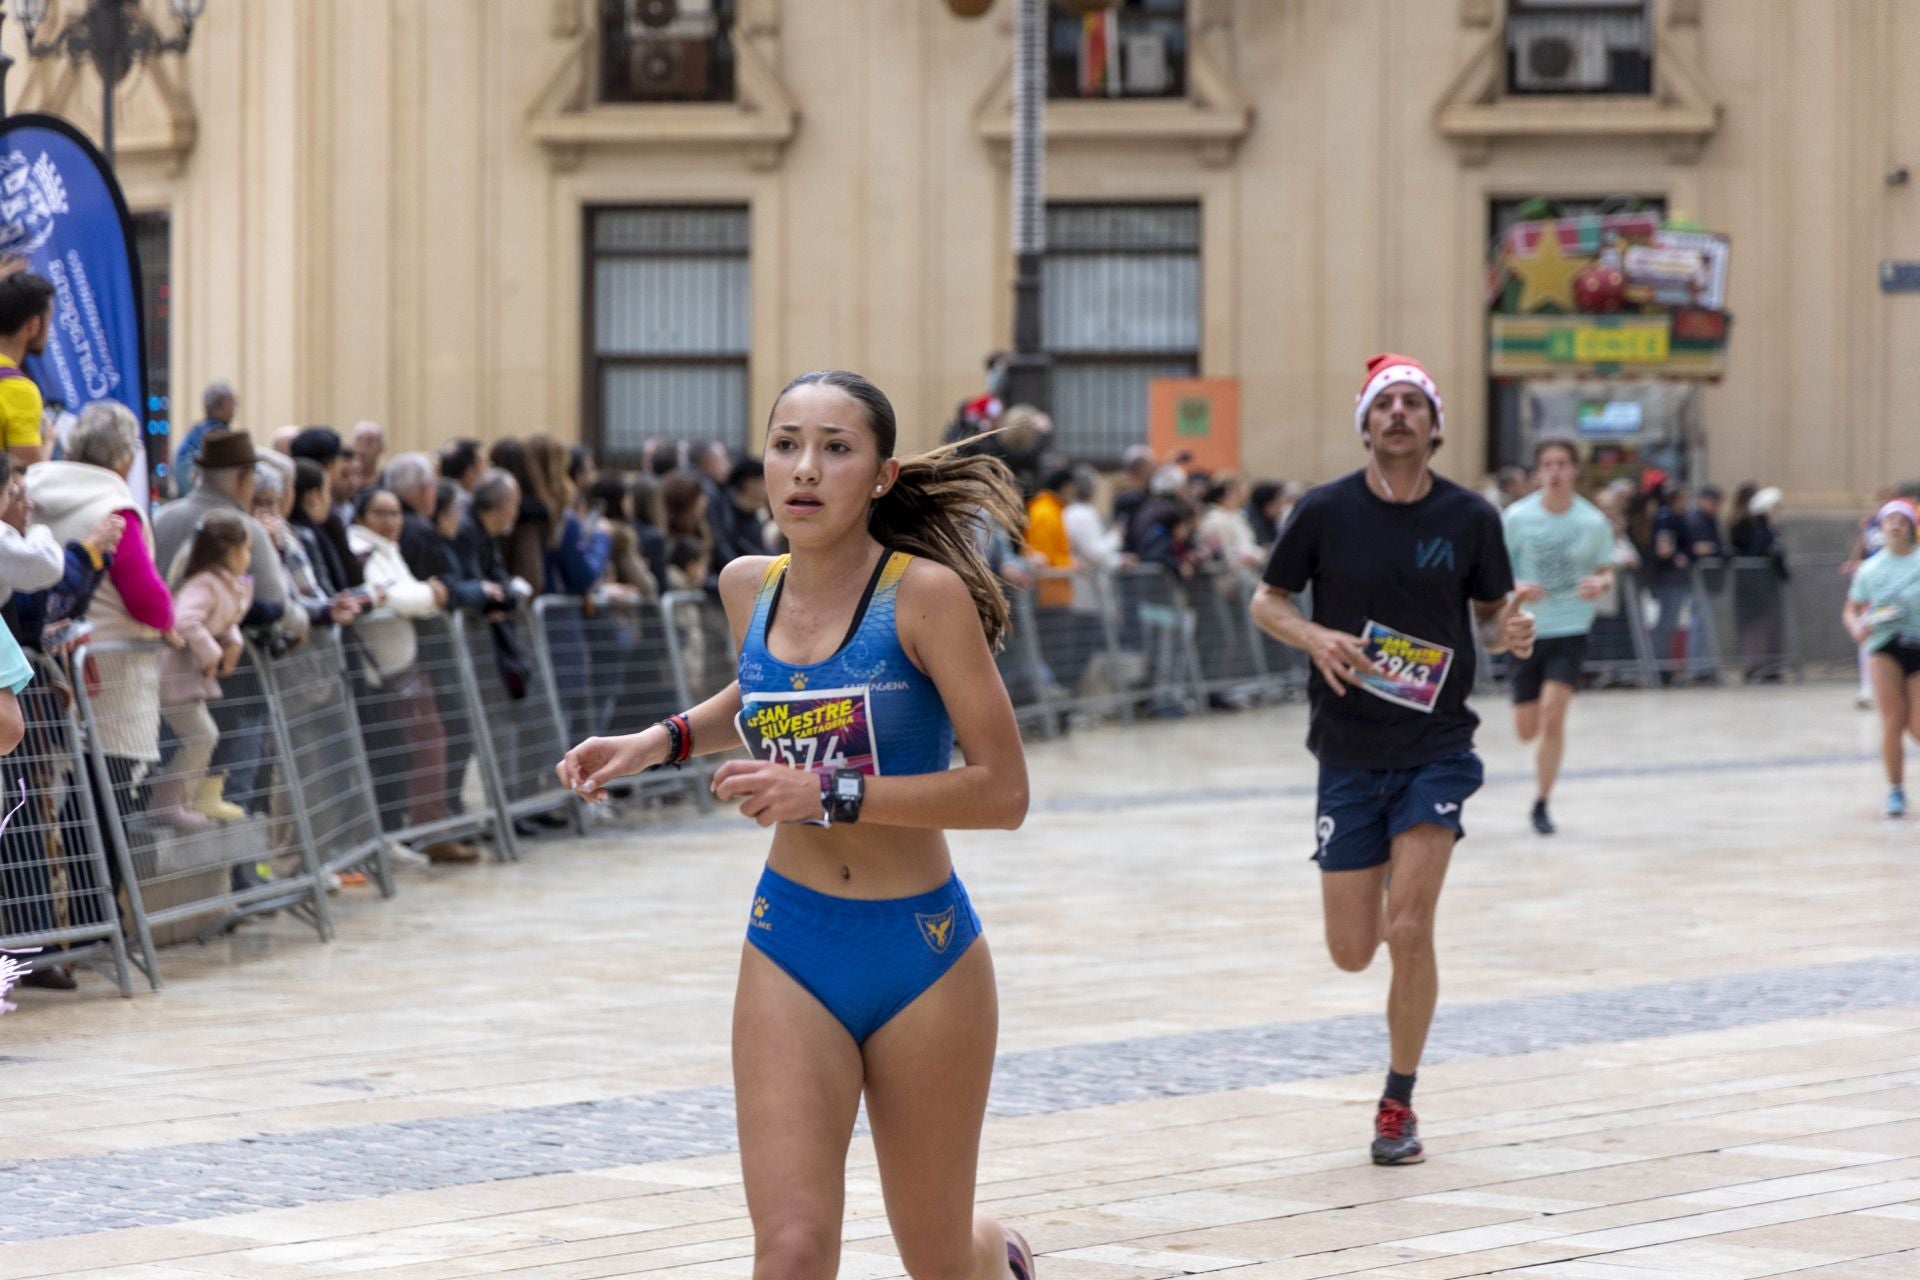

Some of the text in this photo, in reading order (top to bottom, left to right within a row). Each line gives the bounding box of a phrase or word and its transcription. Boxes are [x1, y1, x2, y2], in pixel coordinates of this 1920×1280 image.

[757, 704, 789, 725] SAN
[760, 699, 853, 739] SILVESTRE
[793, 716, 854, 739] CARTAGENA
[761, 735, 846, 773] 2574
